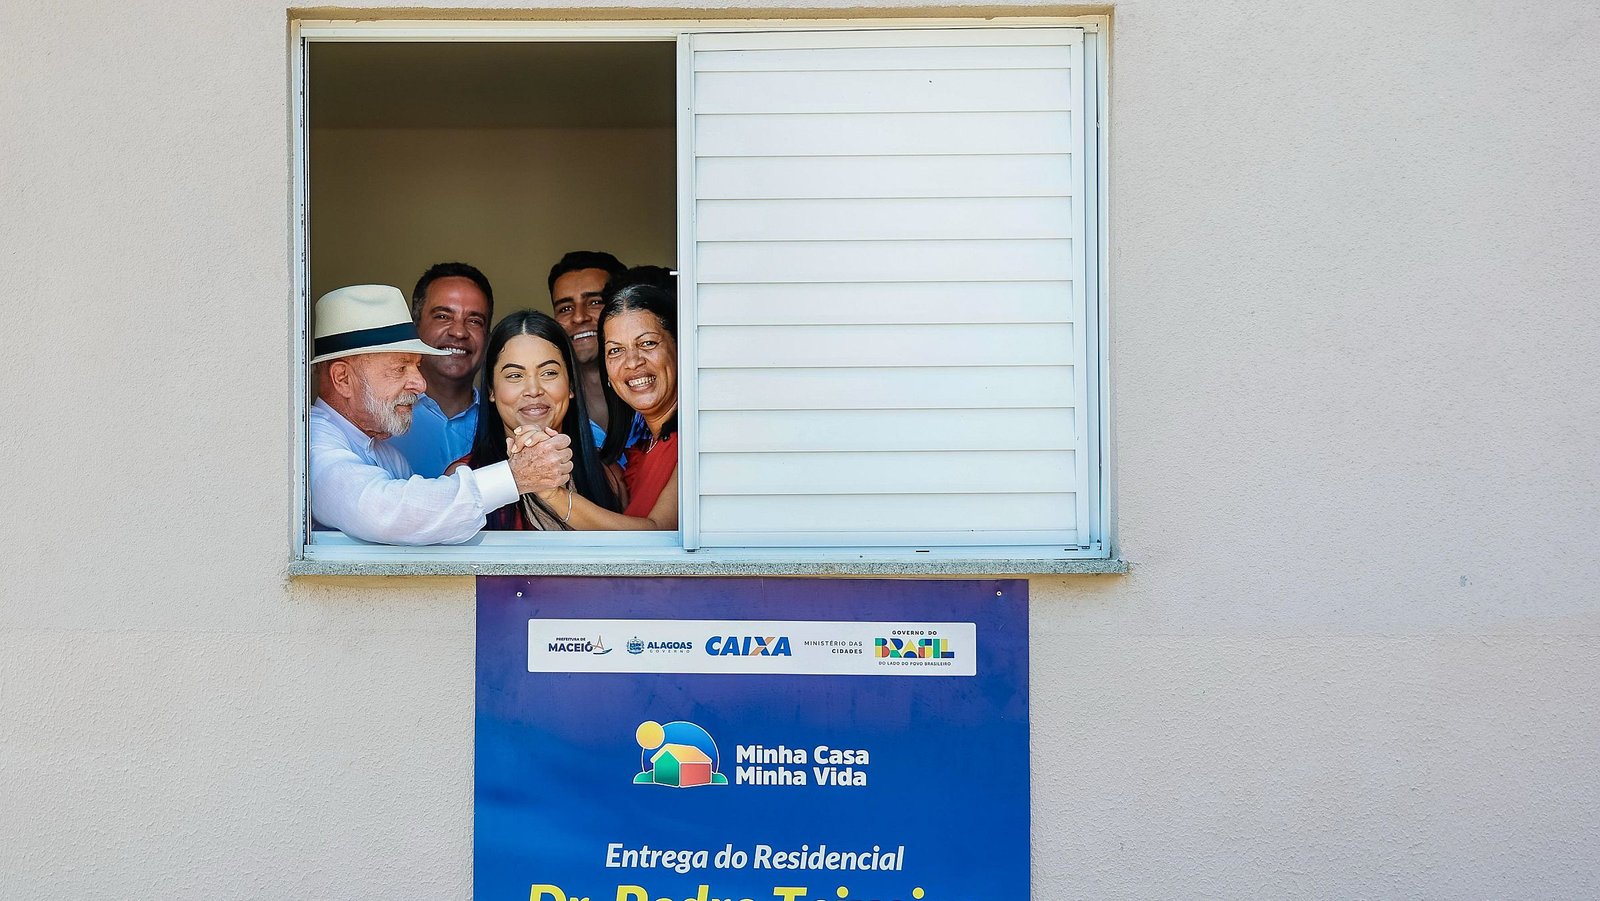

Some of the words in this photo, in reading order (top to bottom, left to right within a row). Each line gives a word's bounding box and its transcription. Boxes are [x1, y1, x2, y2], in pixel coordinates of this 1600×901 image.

[548, 641, 594, 652] MACEIÓ
[647, 641, 693, 650] ALAGOAS
[705, 636, 792, 656] CAIXA
[875, 638, 955, 659] BRASIL
[736, 745, 807, 764] Minha
[813, 746, 870, 765] Casa
[735, 766, 807, 785] Minha
[812, 767, 867, 786] Vida
[605, 843, 709, 874] Entrega
[714, 843, 748, 869] do
[753, 845, 905, 871] Residencial
